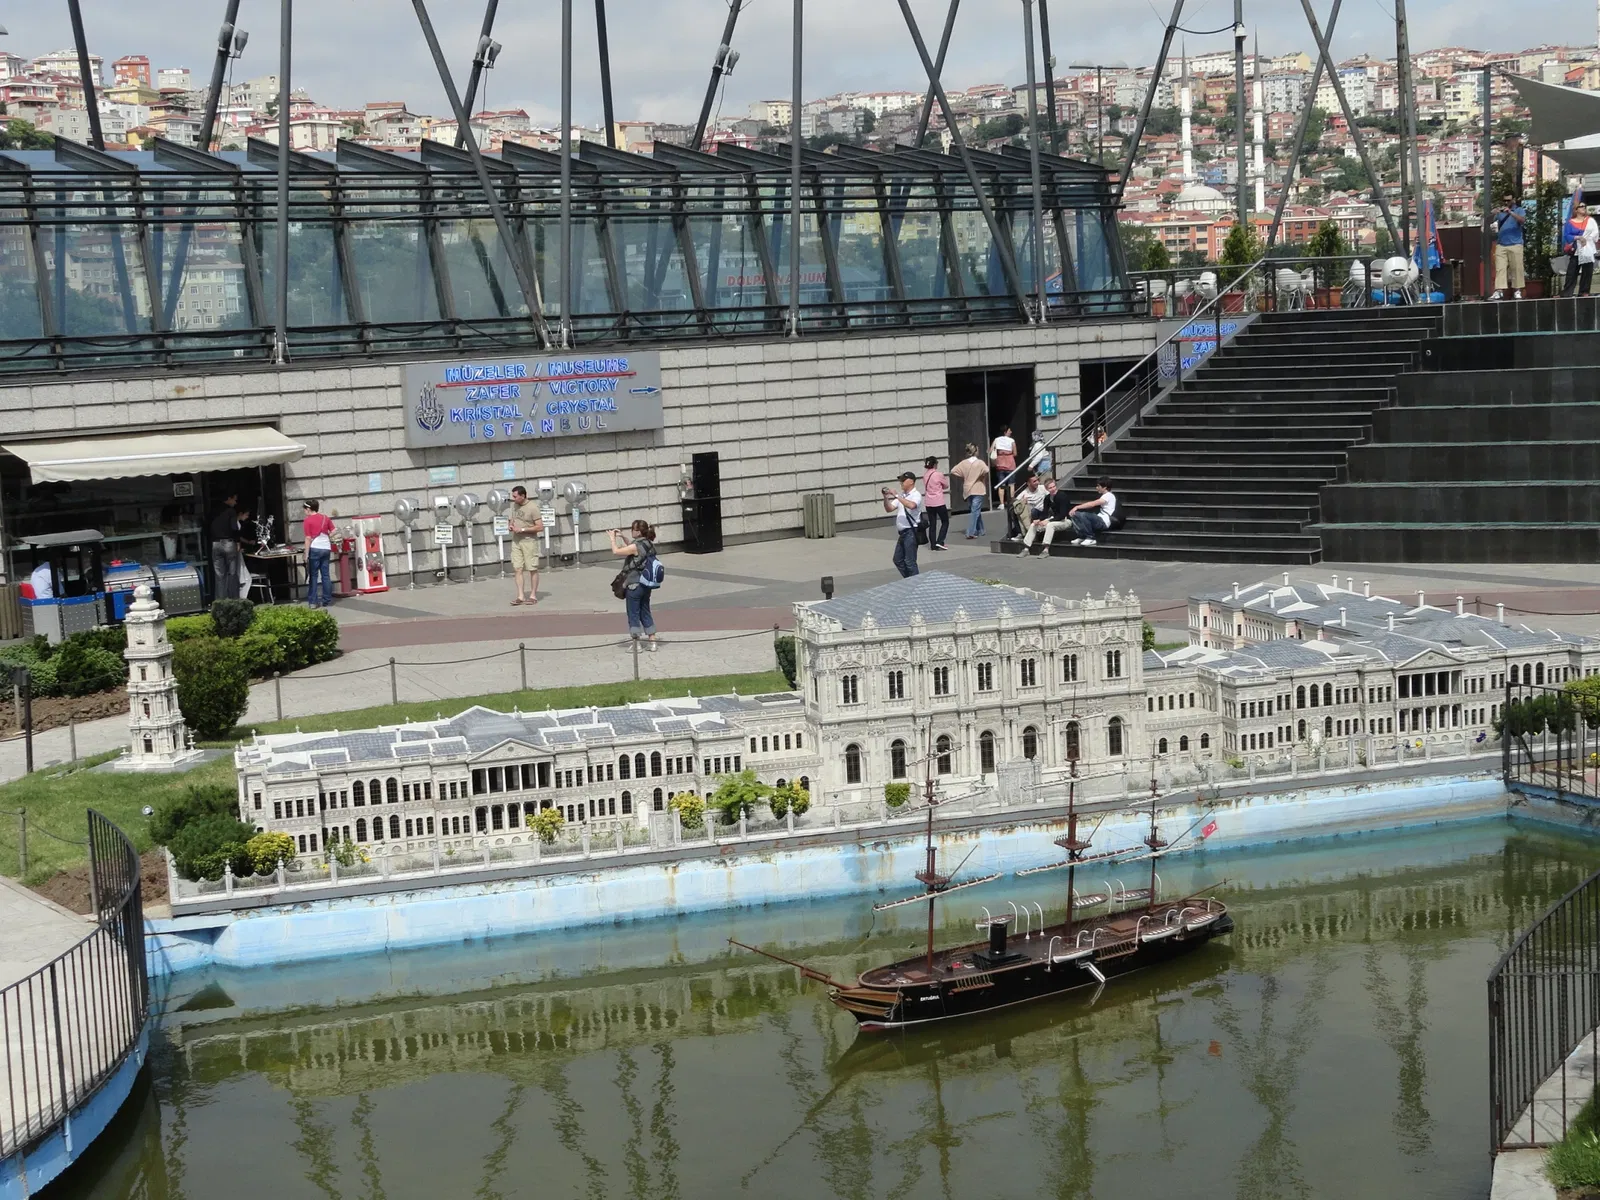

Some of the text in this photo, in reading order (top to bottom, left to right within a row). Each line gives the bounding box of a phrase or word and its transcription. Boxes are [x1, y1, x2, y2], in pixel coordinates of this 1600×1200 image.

[445, 364, 527, 382] MÜZELER
[548, 358, 629, 377] MUSEUMS
[465, 384, 521, 401] ZAFER
[550, 378, 619, 396] VICTORY
[451, 403, 523, 422] KRİSTAL
[547, 398, 618, 416] CRYSTAL
